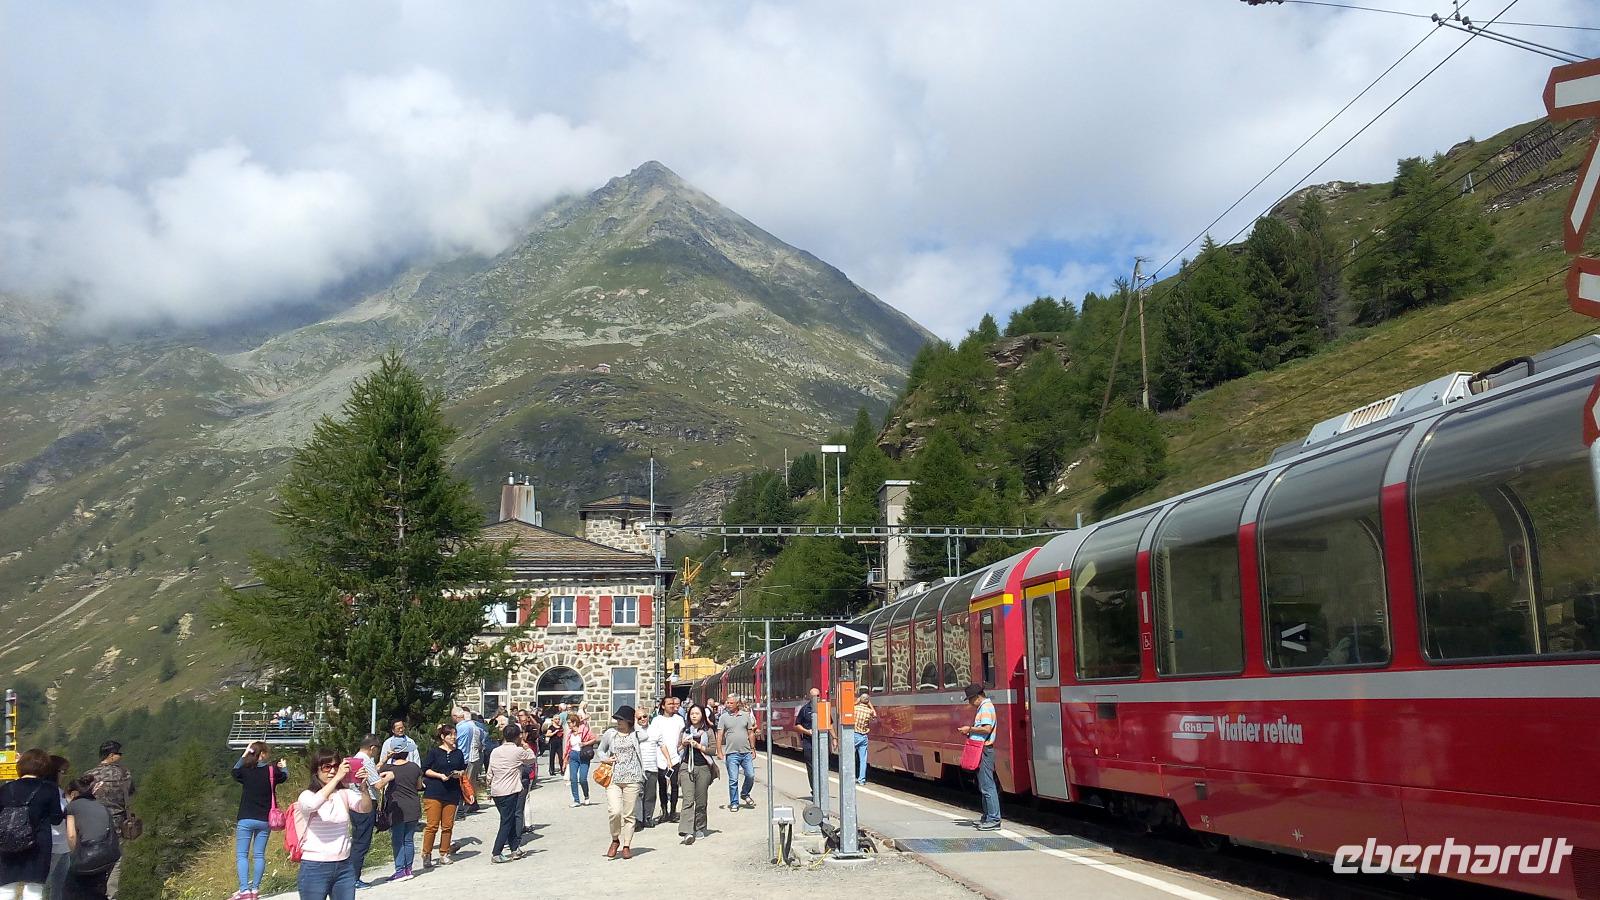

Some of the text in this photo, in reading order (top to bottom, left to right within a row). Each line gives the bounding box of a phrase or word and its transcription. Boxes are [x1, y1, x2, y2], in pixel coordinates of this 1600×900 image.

[576, 642, 620, 652] BUFFET
[1184, 714, 1304, 744] RhB Viafier retica
